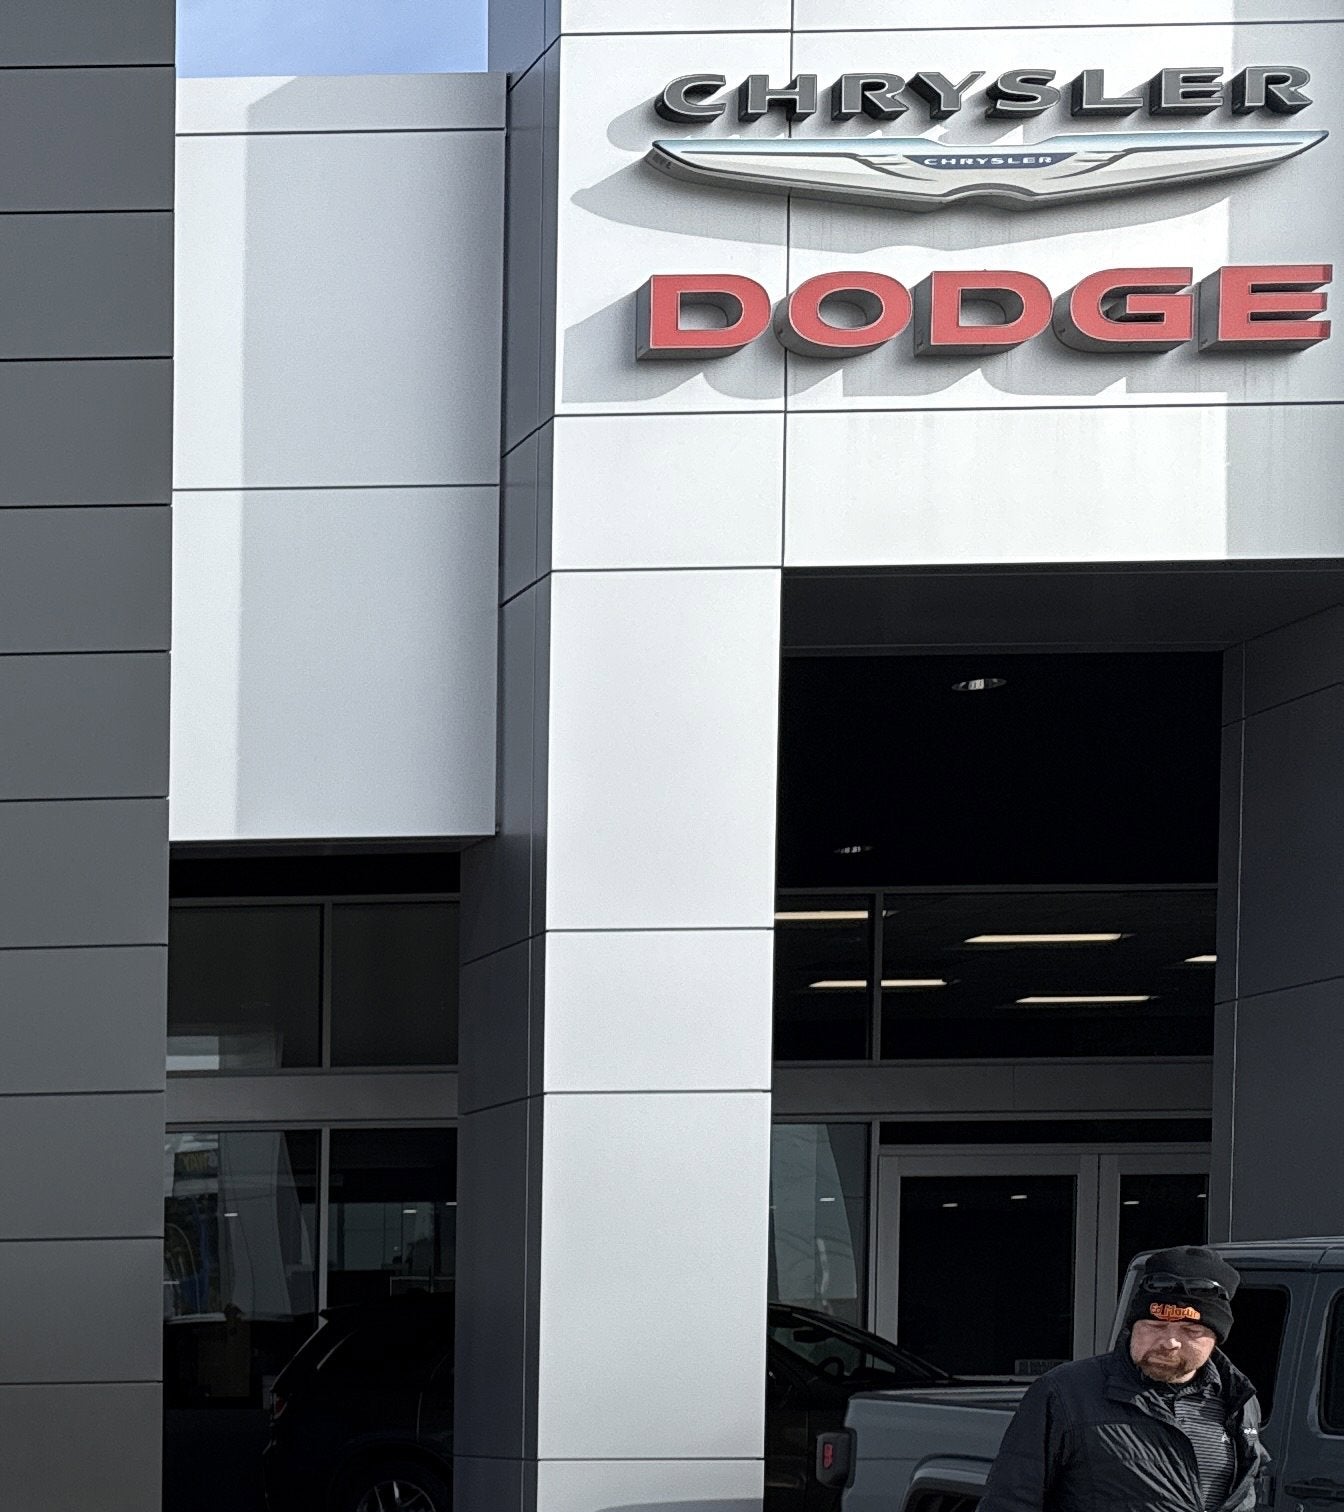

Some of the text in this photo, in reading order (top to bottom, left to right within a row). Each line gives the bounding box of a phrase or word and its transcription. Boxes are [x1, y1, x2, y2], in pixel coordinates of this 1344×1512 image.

[656, 66, 1314, 123] CHRYSLER
[922, 153, 1054, 168] CHRYSLER
[636, 264, 1333, 361] DODGE
